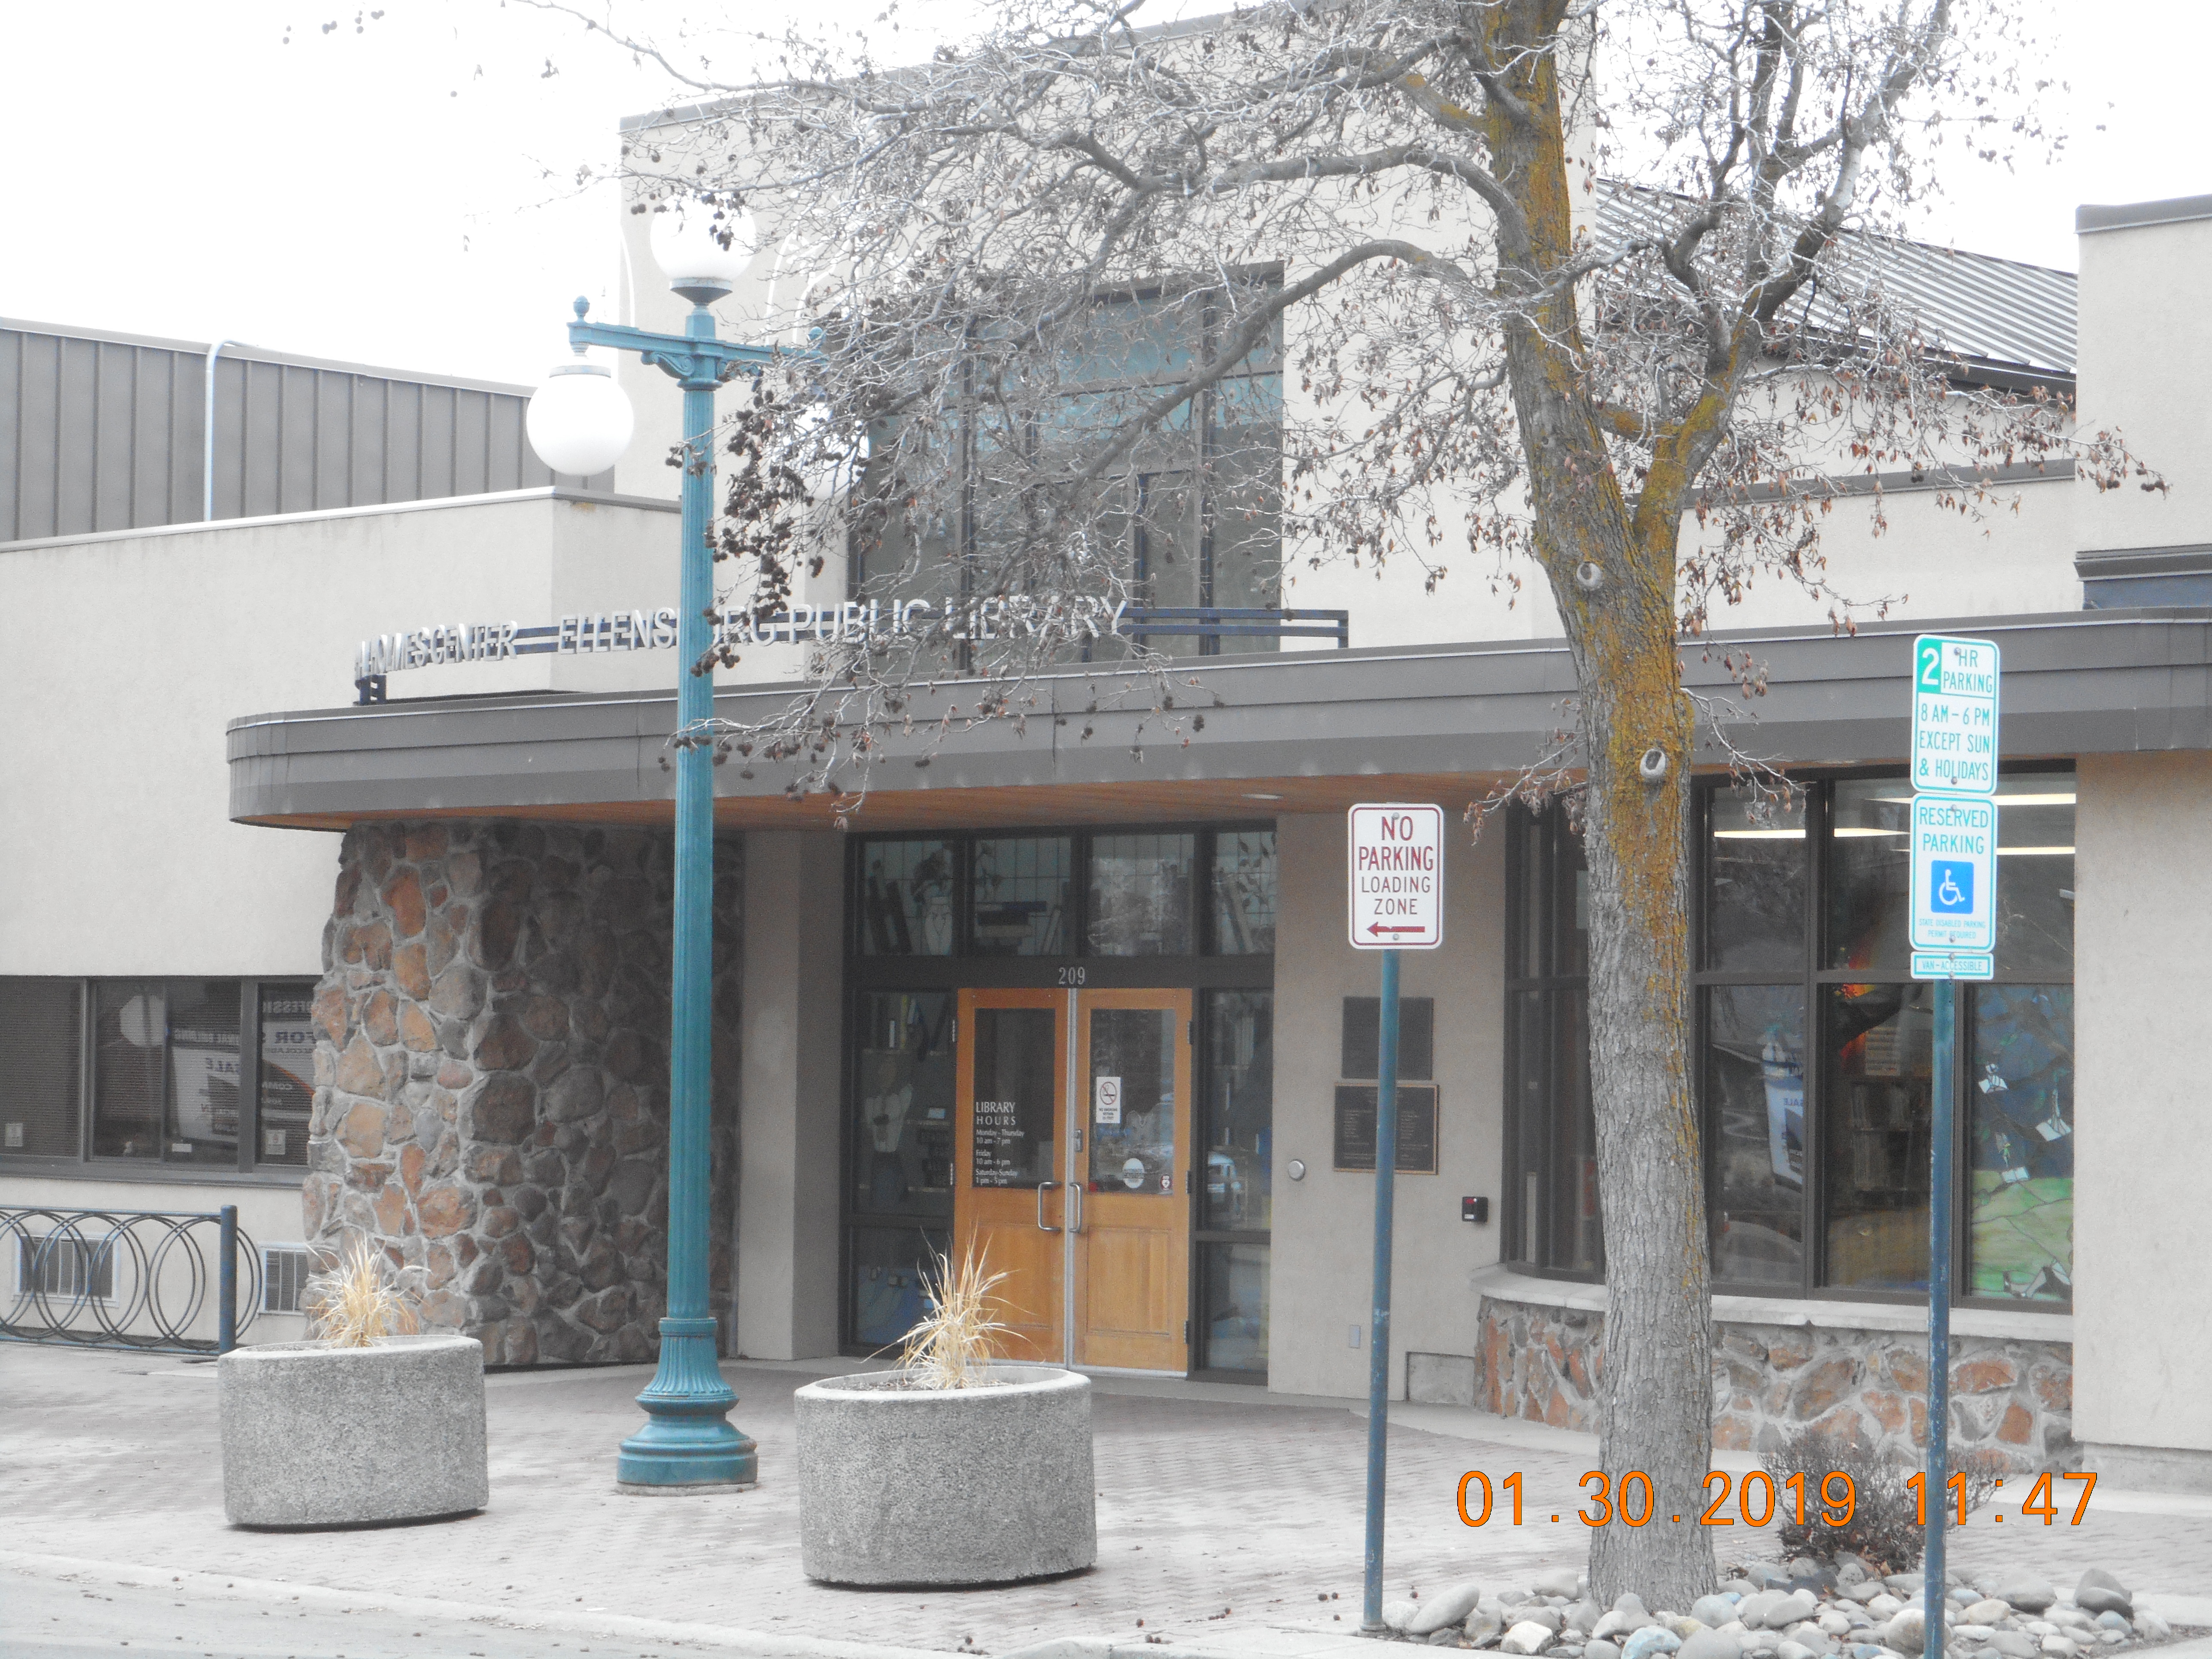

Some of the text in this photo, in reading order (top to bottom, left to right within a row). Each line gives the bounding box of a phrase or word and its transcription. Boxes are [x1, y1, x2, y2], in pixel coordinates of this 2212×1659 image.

[789, 599, 931, 644] PUBLIC
[1922, 648, 1978, 685] 2 HR
[1943, 671, 1992, 693] PARKING
[1921, 703, 1928, 722] 8
[1932, 704, 1948, 723] AM
[1963, 707, 1970, 725] 6
[1975, 708, 1990, 726] PM
[1920, 730, 1990, 754] EXCEPT SUN
[1920, 758, 1988, 781] & HOLIDAYS
[1919, 806, 1988, 828] RESERVED
[1381, 816, 1413, 841] NO
[1923, 833, 1984, 854] PARKING
[1358, 846, 1434, 871] PARKING
[1361, 876, 1431, 893] LOADING
[1374, 898, 1418, 915] ZONE
[1936, 919, 1961, 927] DISABLED
[1963, 920, 1986, 929] PARKING
[1058, 967, 1085, 985] 209
[976, 1102, 1016, 1113] LIBRARY
[977, 1116, 1016, 1125] HOURS
[976, 1128, 997, 1137] Monday
[1002, 1129, 1025, 1138] Thursday
[976, 1149, 992, 1158] Friday
